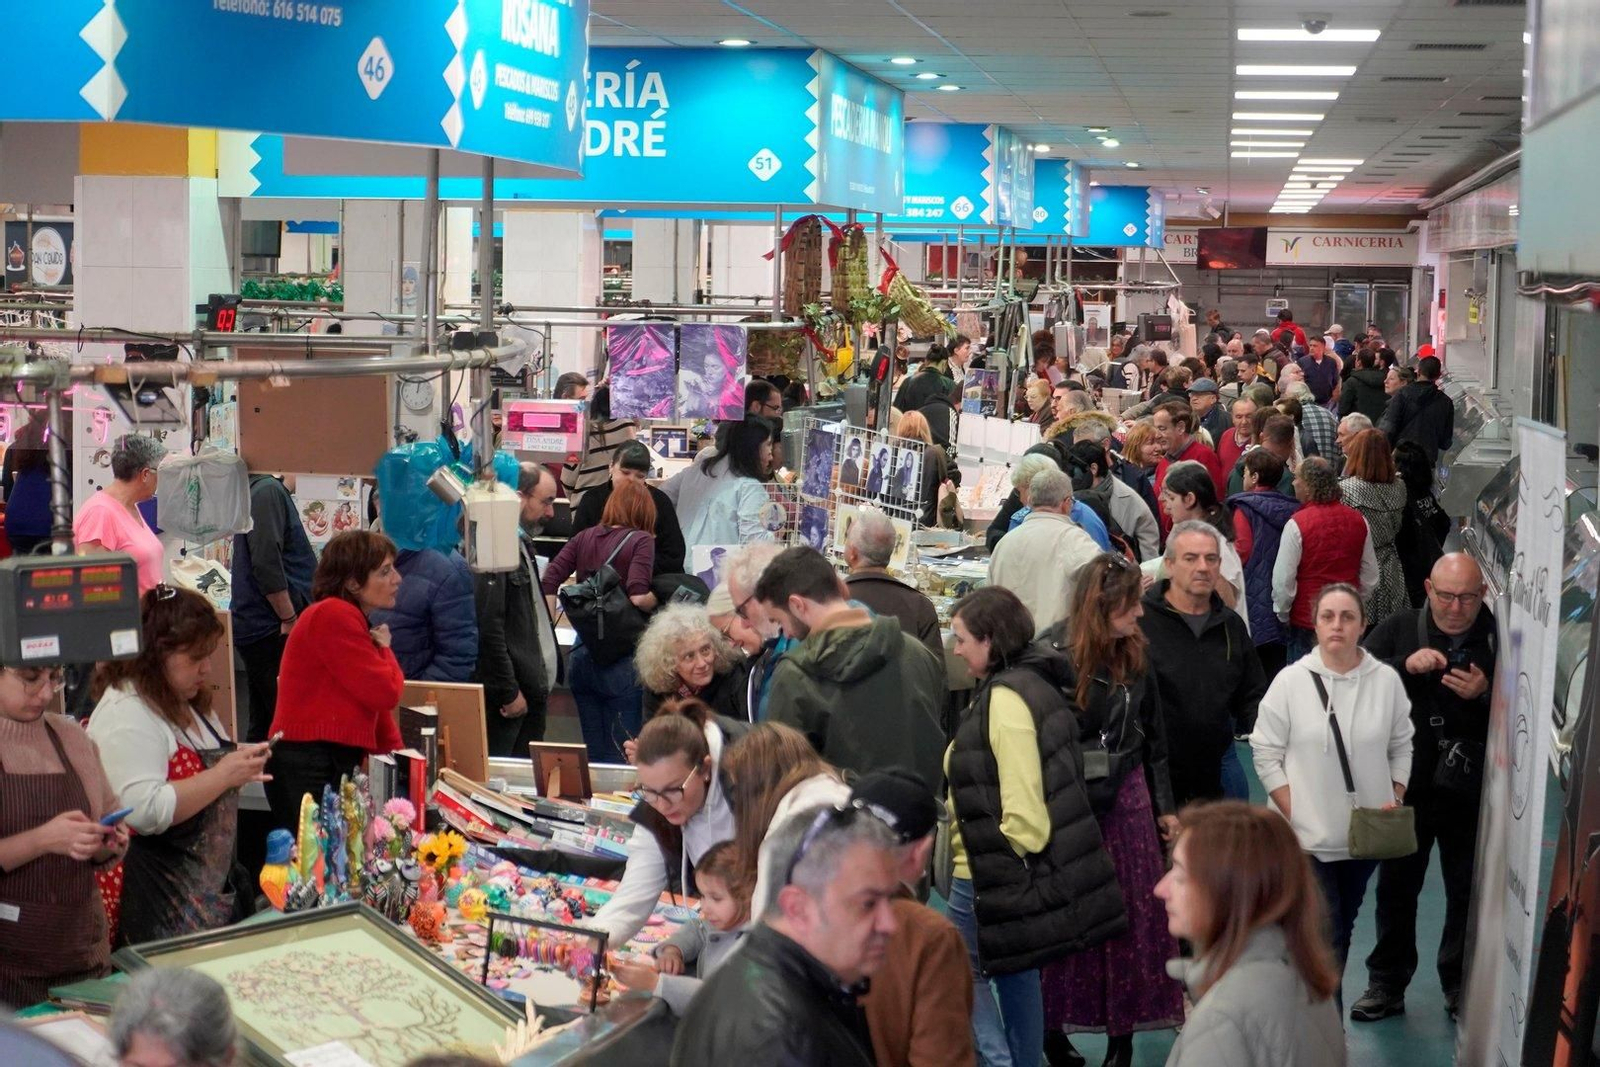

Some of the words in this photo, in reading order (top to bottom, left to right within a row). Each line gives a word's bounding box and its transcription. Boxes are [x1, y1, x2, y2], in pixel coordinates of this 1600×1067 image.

[273, 1, 294, 20] 616
[296, 3, 318, 23] 514
[320, 7, 341, 27] 075
[501, 0, 560, 58] ROSANA
[363, 56, 385, 82] 46
[586, 58, 670, 108] RÍA
[585, 107, 667, 157] DRÉ
[755, 157, 772, 171] 51
[954, 202, 970, 213] 66
[1312, 235, 1405, 249] CARNICERIA
